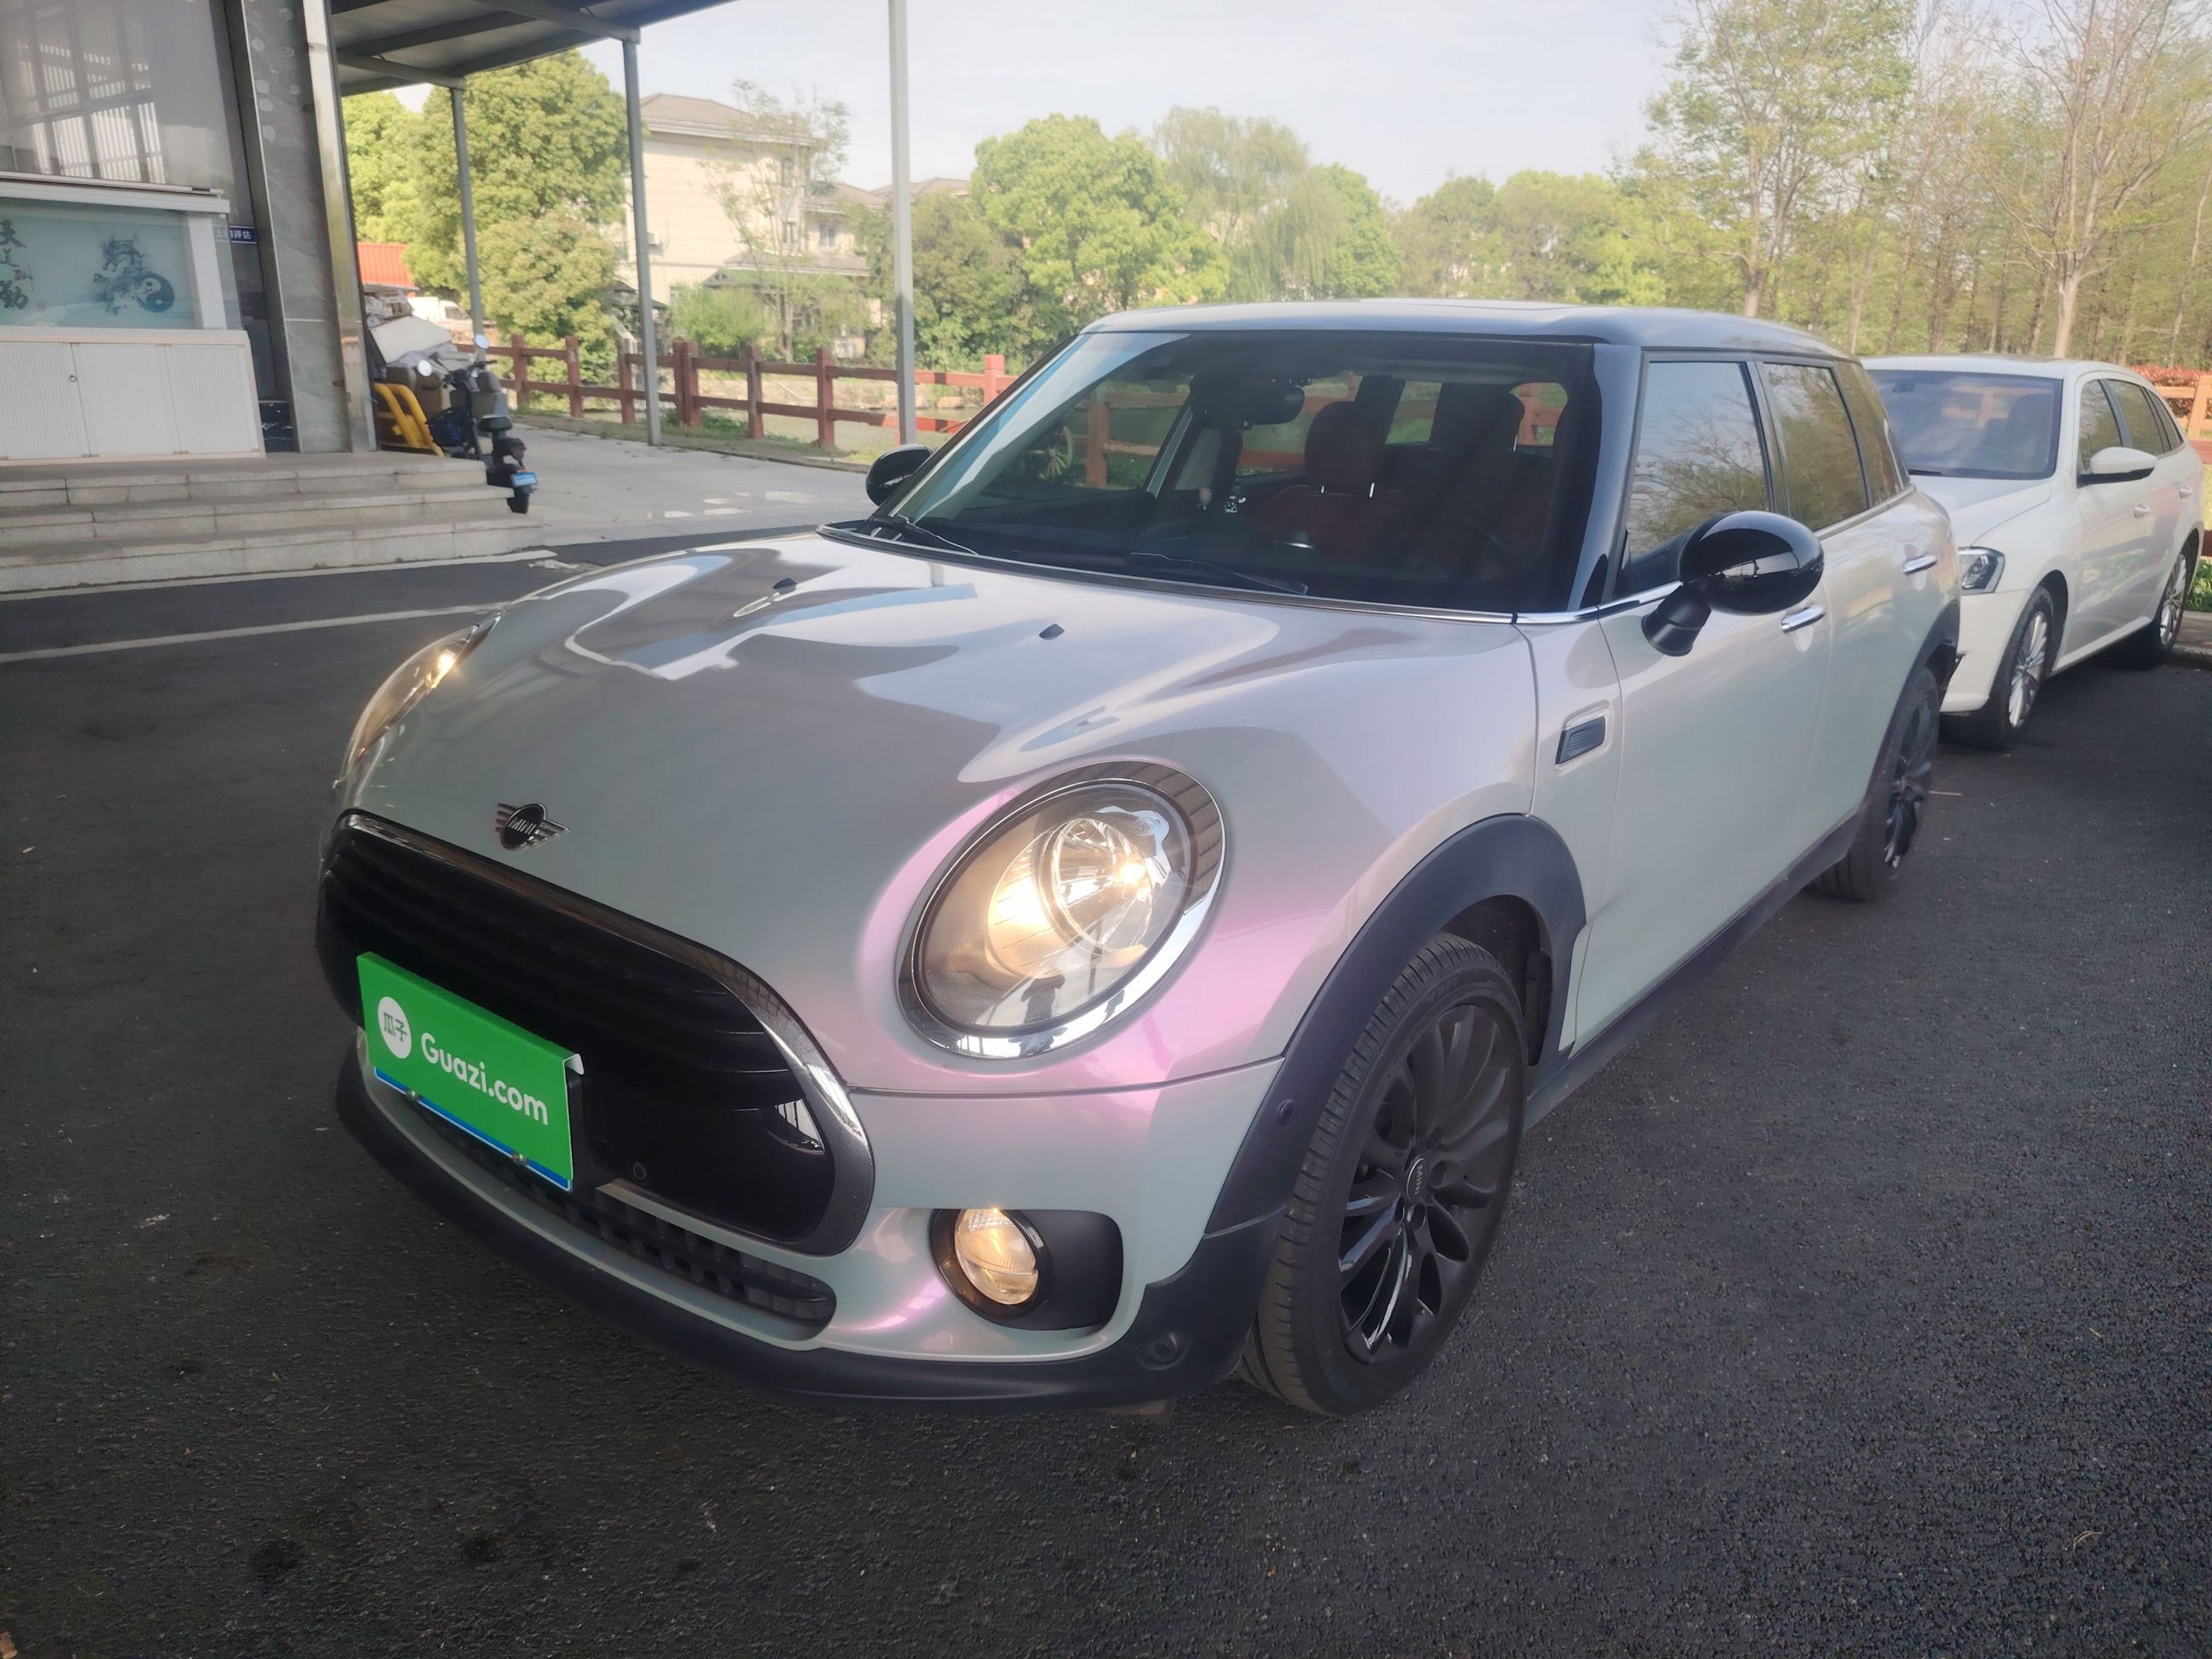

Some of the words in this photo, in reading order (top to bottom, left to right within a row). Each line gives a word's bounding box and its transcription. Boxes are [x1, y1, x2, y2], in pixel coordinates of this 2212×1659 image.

[507, 817, 536, 835] MINI
[383, 1012, 407, 1042] 瓜子
[421, 1033, 548, 1125] Guazi.com
[1414, 1165, 1423, 1195] MINI
